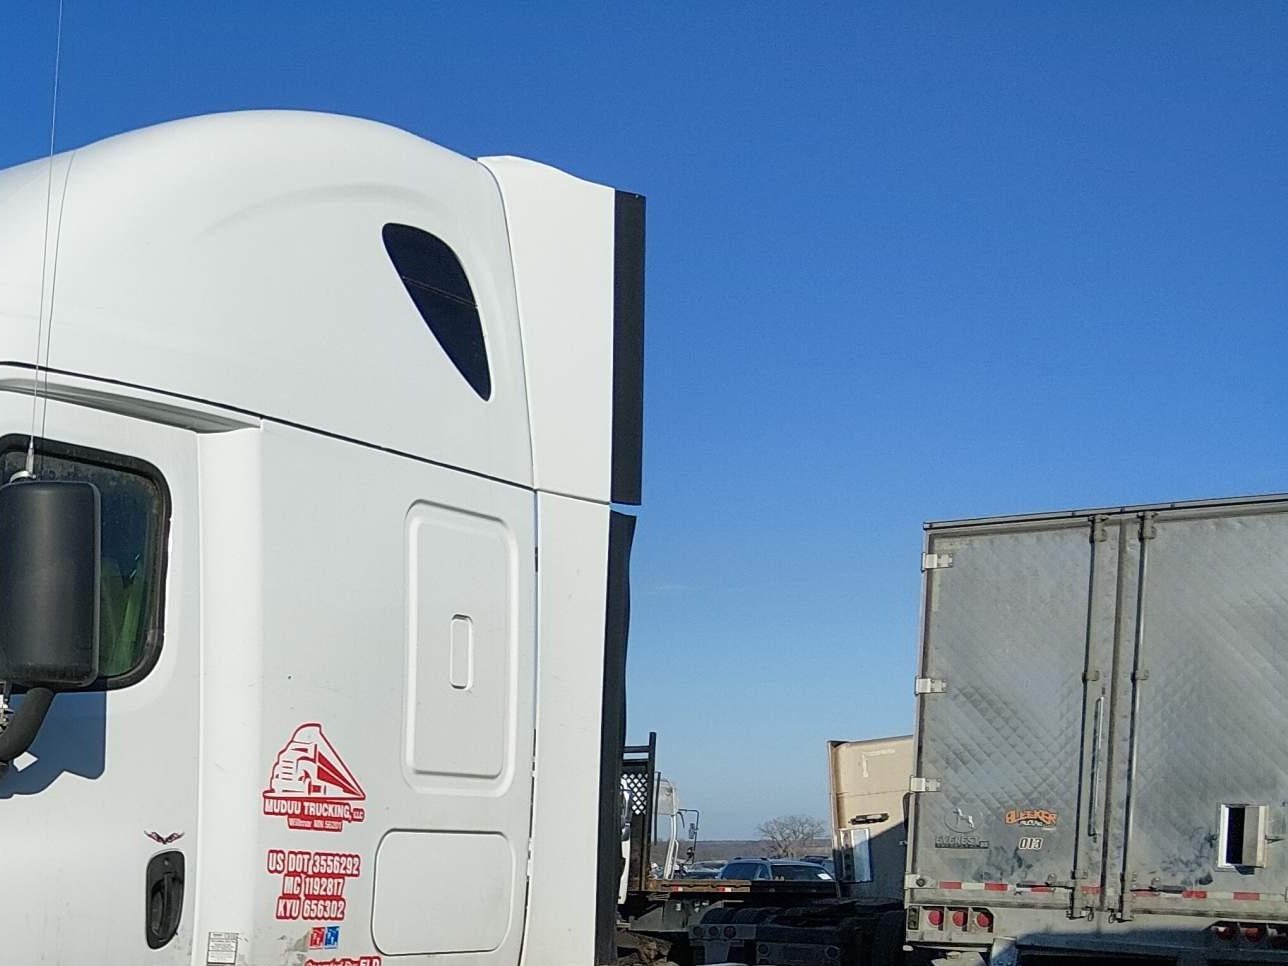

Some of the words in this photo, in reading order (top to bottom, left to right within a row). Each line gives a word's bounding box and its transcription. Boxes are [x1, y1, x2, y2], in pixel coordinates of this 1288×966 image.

[265, 799, 301, 814] MUDUU
[1019, 837, 1043, 850] 013
[269, 852, 284, 871] US
[288, 854, 309, 873] DOT
[312, 855, 359, 875] 3556292
[284, 876, 301, 894] MC
[305, 877, 344, 895] 1192817
[277, 899, 299, 917] KYU
[303, 901, 345, 918] 656302
